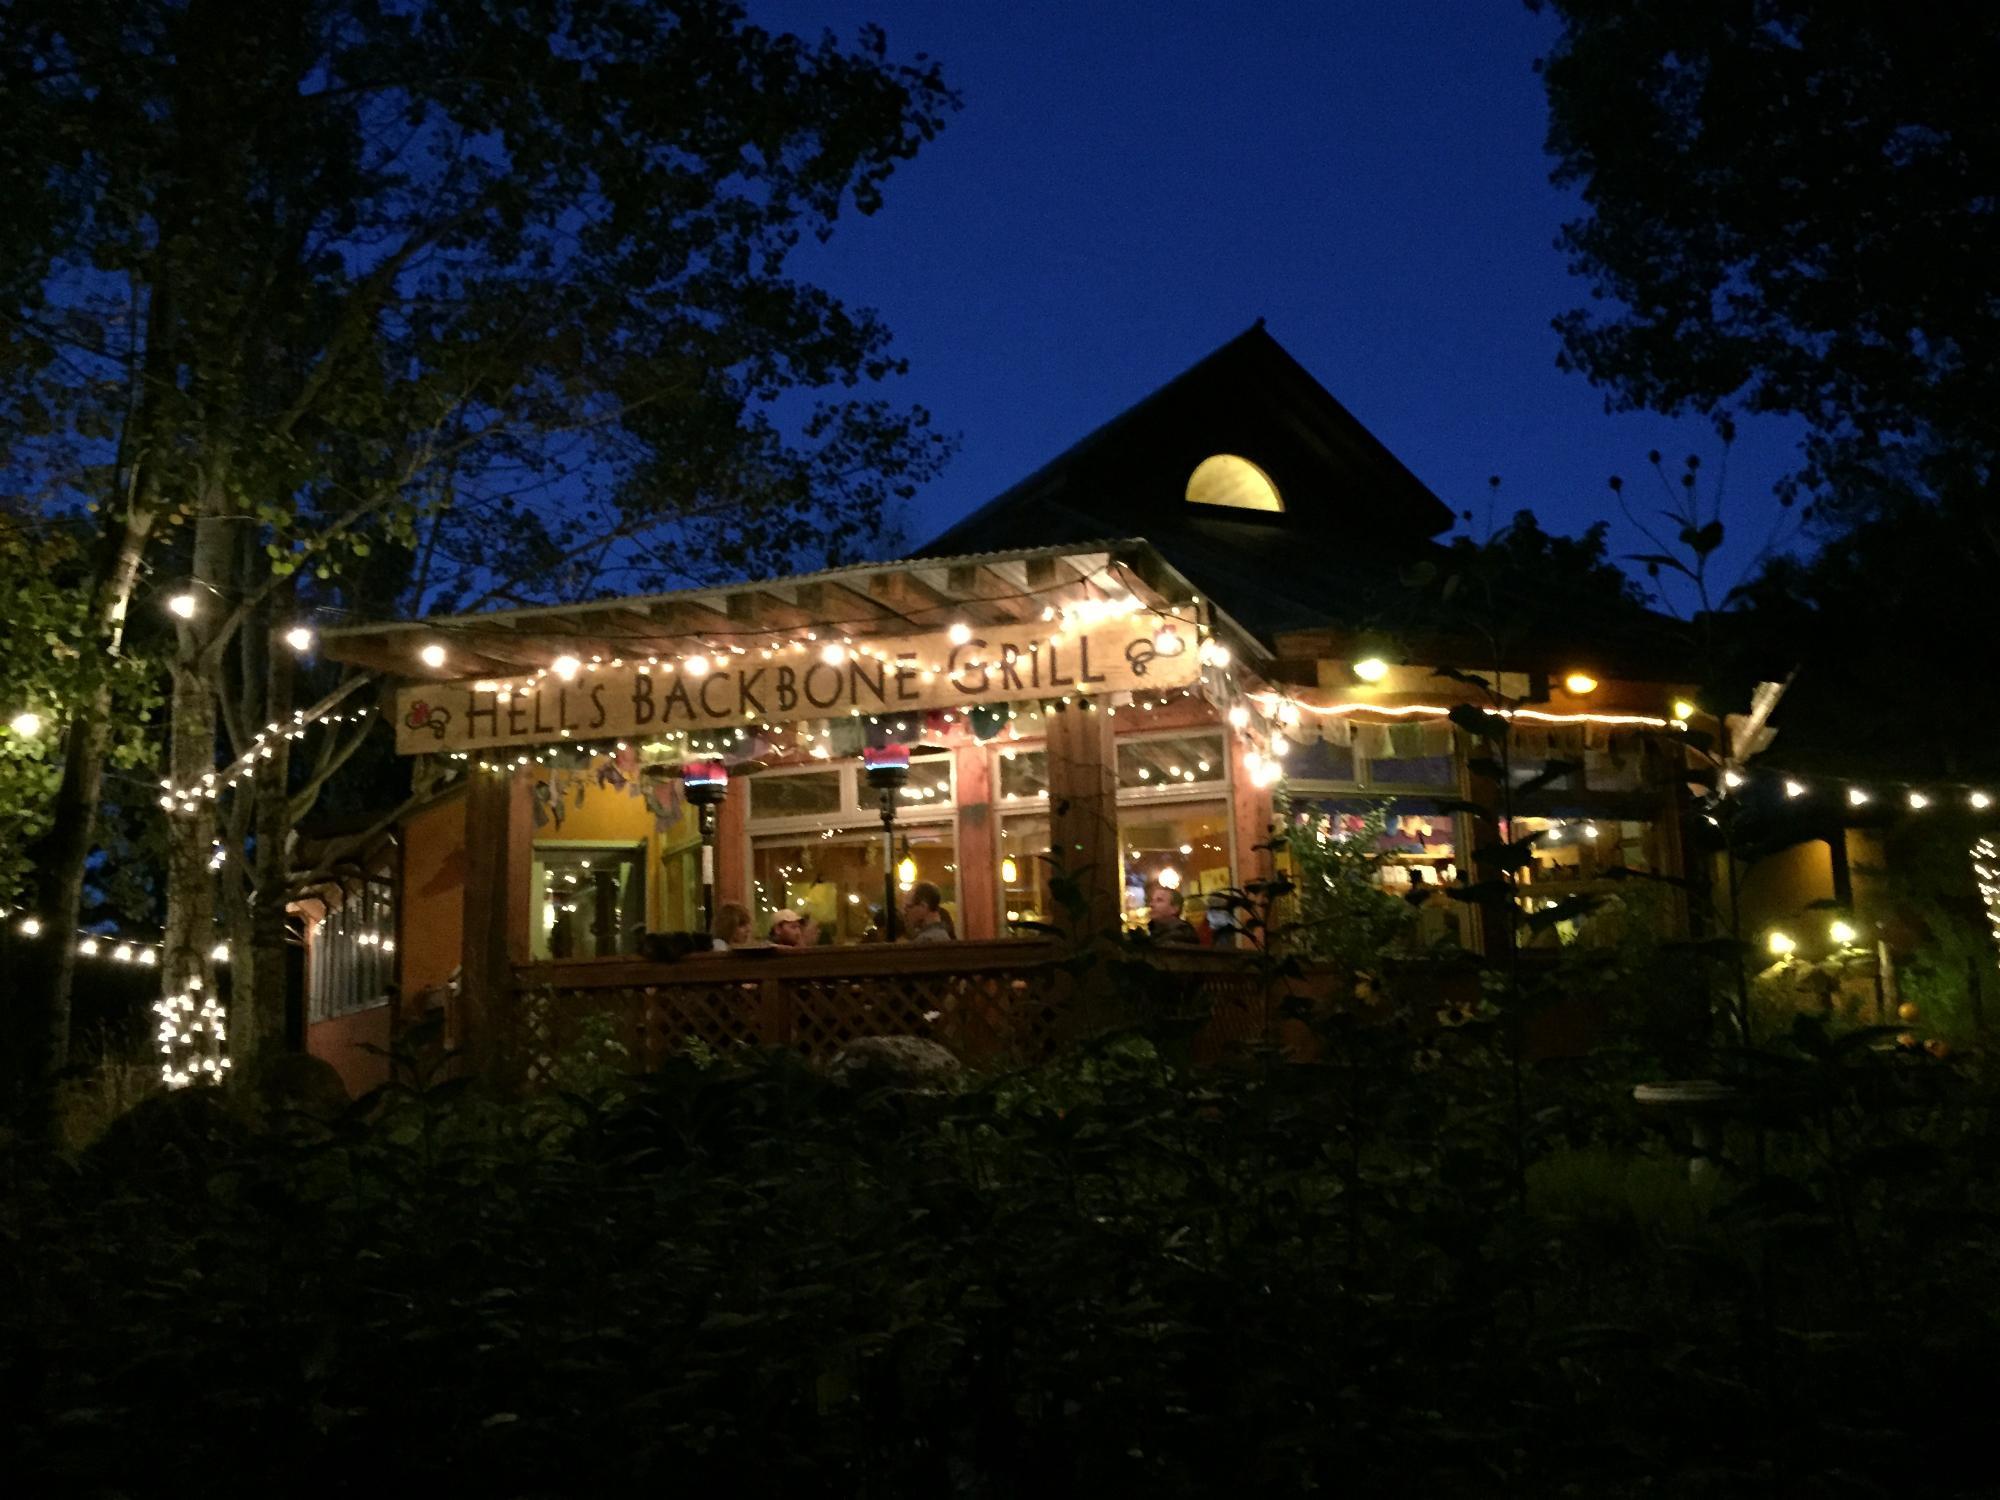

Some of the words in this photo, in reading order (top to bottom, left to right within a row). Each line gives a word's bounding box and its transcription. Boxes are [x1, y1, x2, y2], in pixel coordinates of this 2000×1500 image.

[465, 678, 606, 739] HELL'S
[632, 653, 920, 725] BACKBONE
[947, 635, 1105, 695] GRILL
